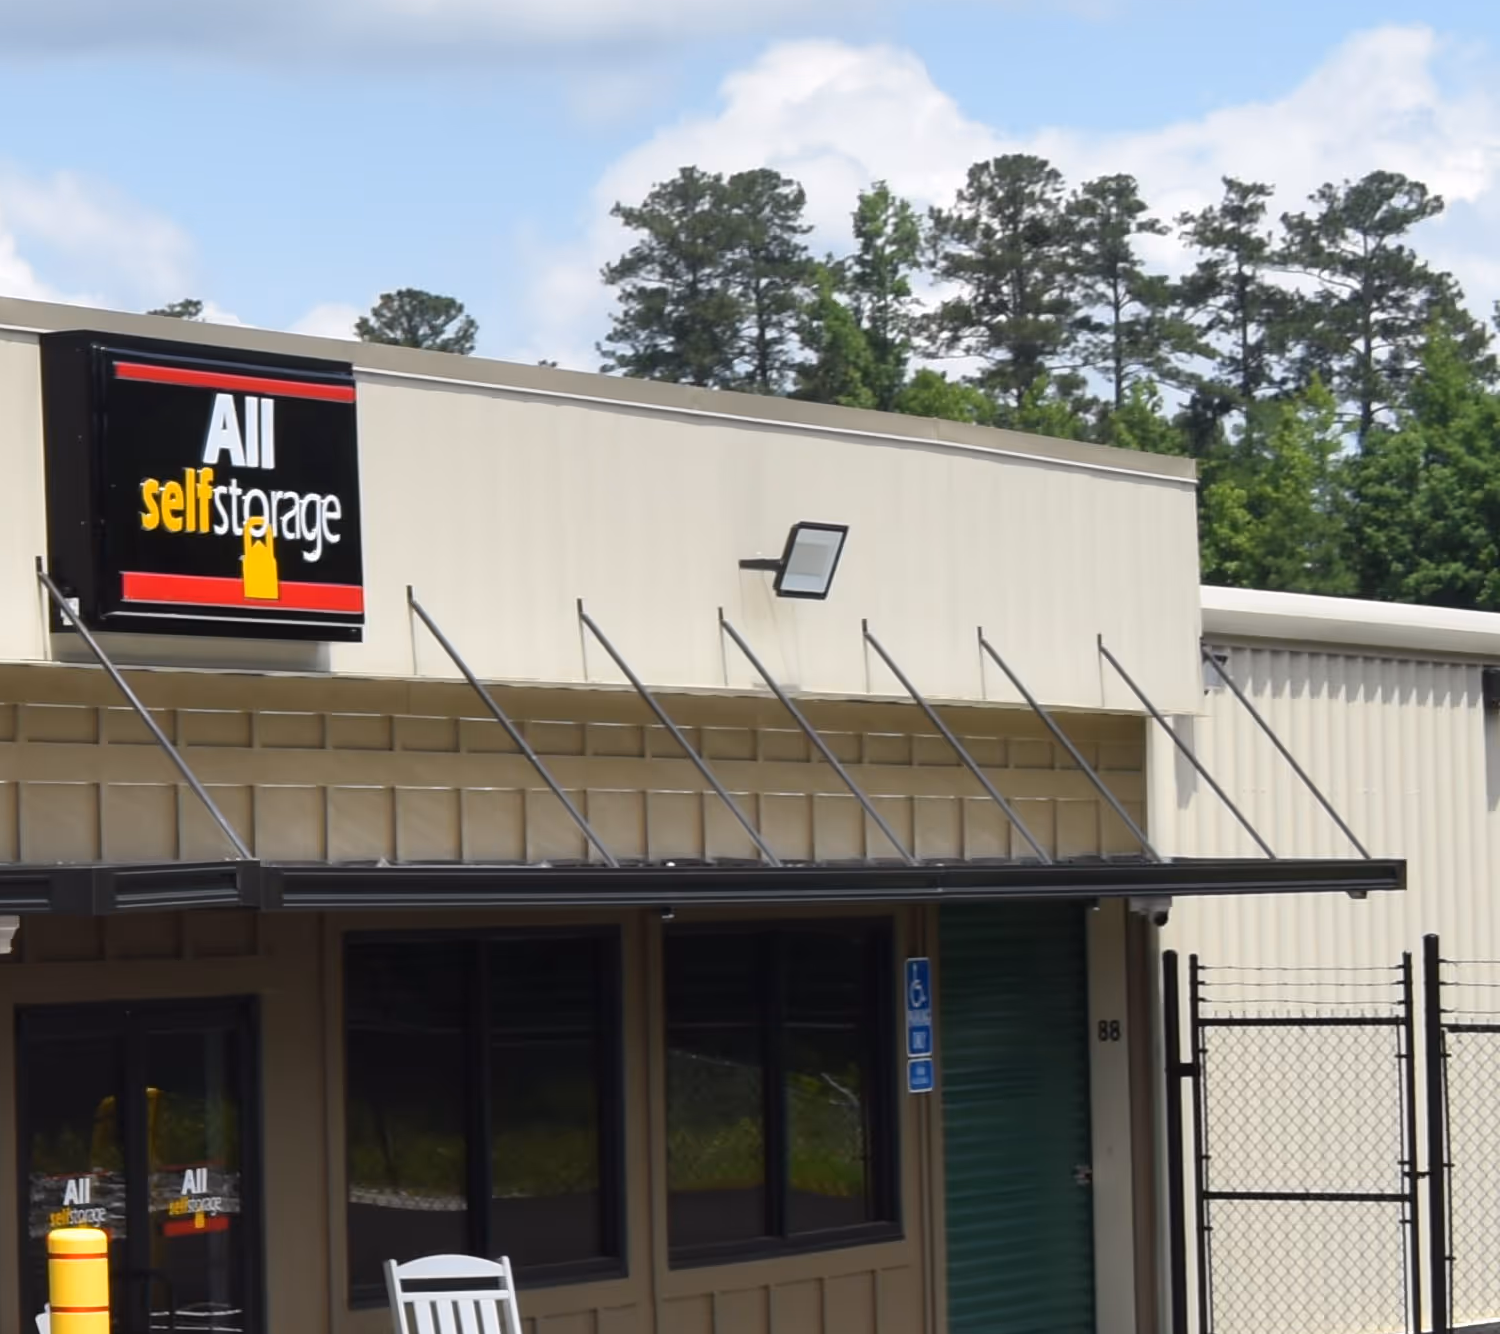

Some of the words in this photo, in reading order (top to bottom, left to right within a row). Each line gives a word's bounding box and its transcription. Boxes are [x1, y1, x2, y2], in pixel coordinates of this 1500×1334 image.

[202, 393, 275, 469] All
[1098, 1020, 1121, 1041] 88
[63, 1178, 90, 1205] All
[181, 1168, 207, 1195] All
